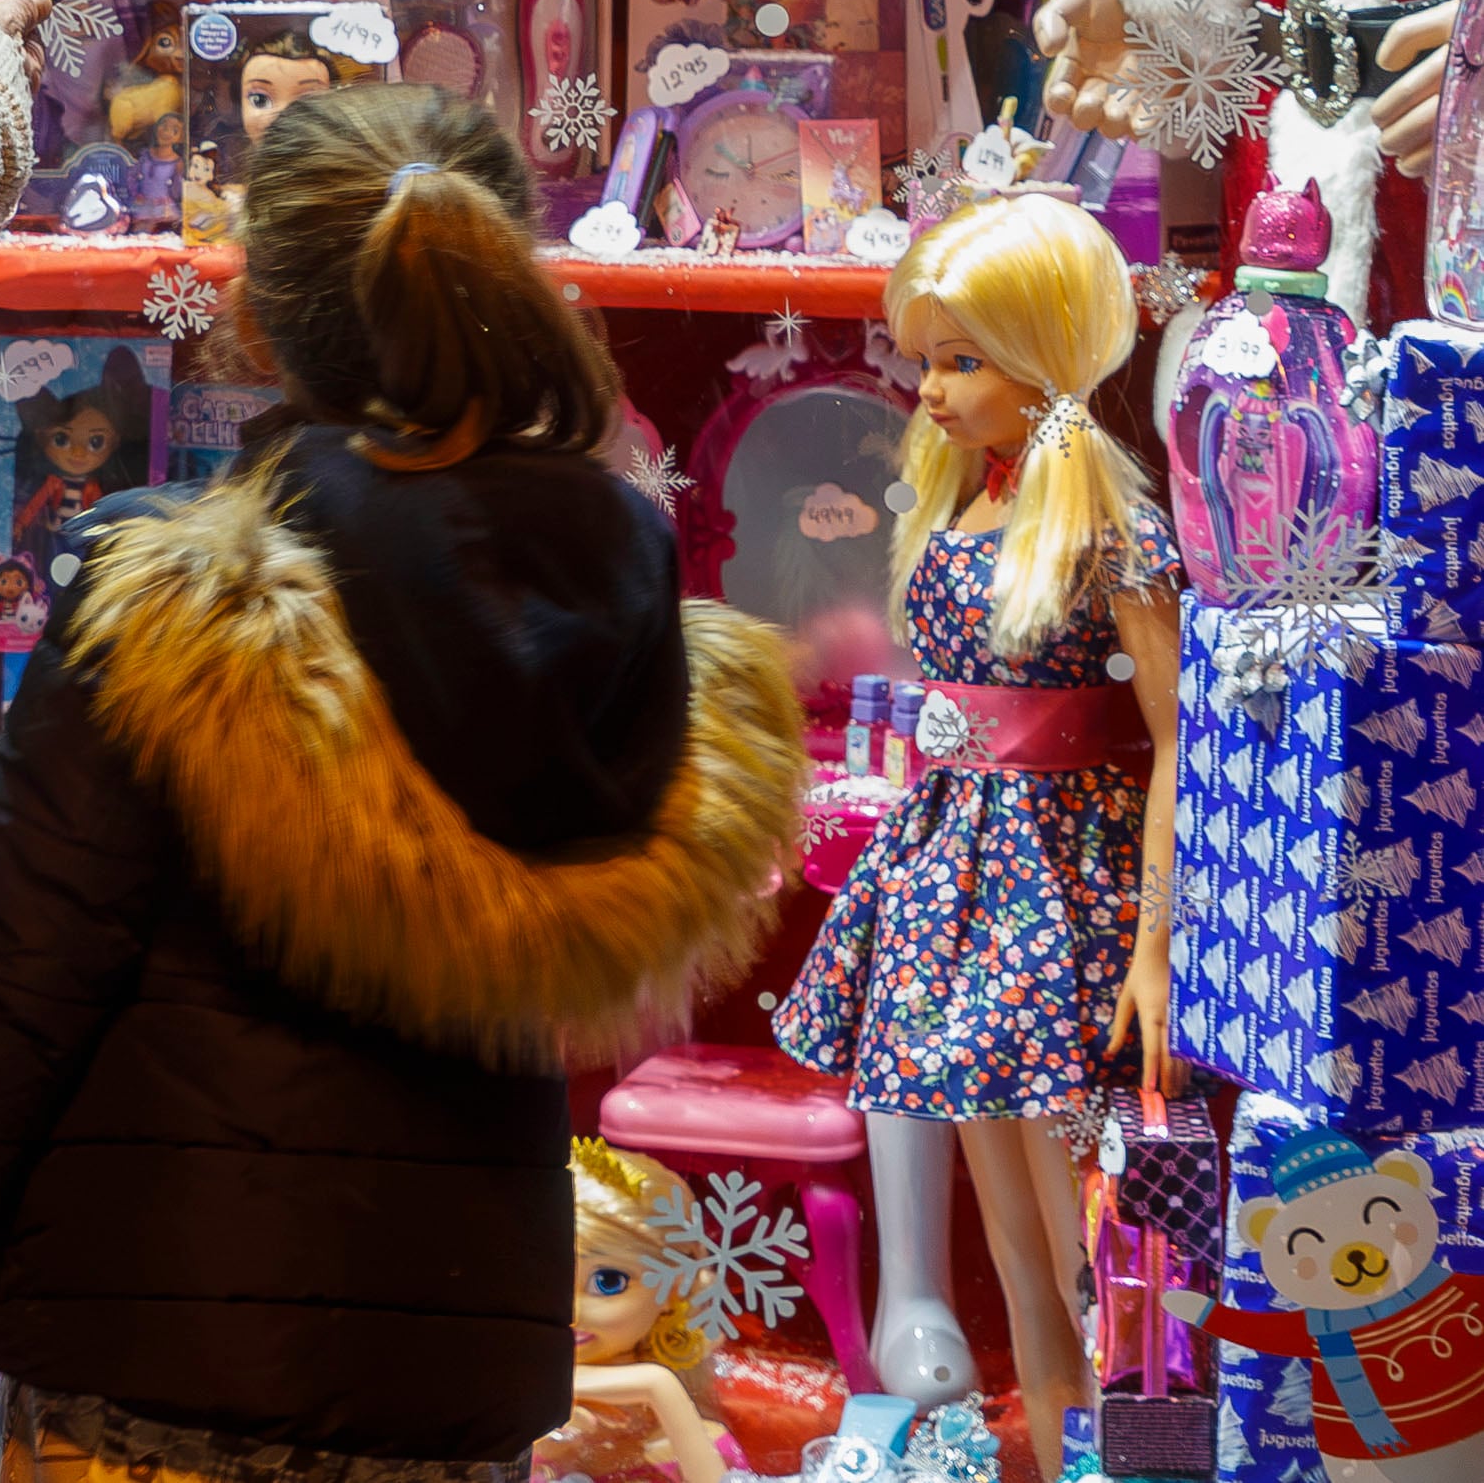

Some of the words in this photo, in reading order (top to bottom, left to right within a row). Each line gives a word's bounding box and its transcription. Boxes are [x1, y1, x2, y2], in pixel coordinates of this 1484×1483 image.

[332, 23, 384, 51] 14'99
[863, 227, 910, 249] 4'95
[1438, 378, 1457, 450] juguettos
[1386, 445, 1403, 519] juguettos
[1443, 515, 1463, 589] juguettos
[1327, 688, 1342, 761] juguettos
[1432, 692, 1448, 765] juguettos
[1300, 750, 1313, 824] juguettos
[1378, 760, 1394, 833] juguettos
[1274, 815, 1286, 886] juguettos
[1426, 832, 1445, 904] juguettos
[1295, 889, 1307, 962] juguettos
[1373, 900, 1389, 972] juguettos
[1271, 951, 1282, 1024] juguettos
[1318, 966, 1332, 1039] juguettos
[1422, 970, 1439, 1043] juguettos
[1292, 1027, 1303, 1100] juguettos
[1368, 1039, 1384, 1111] juguettos
